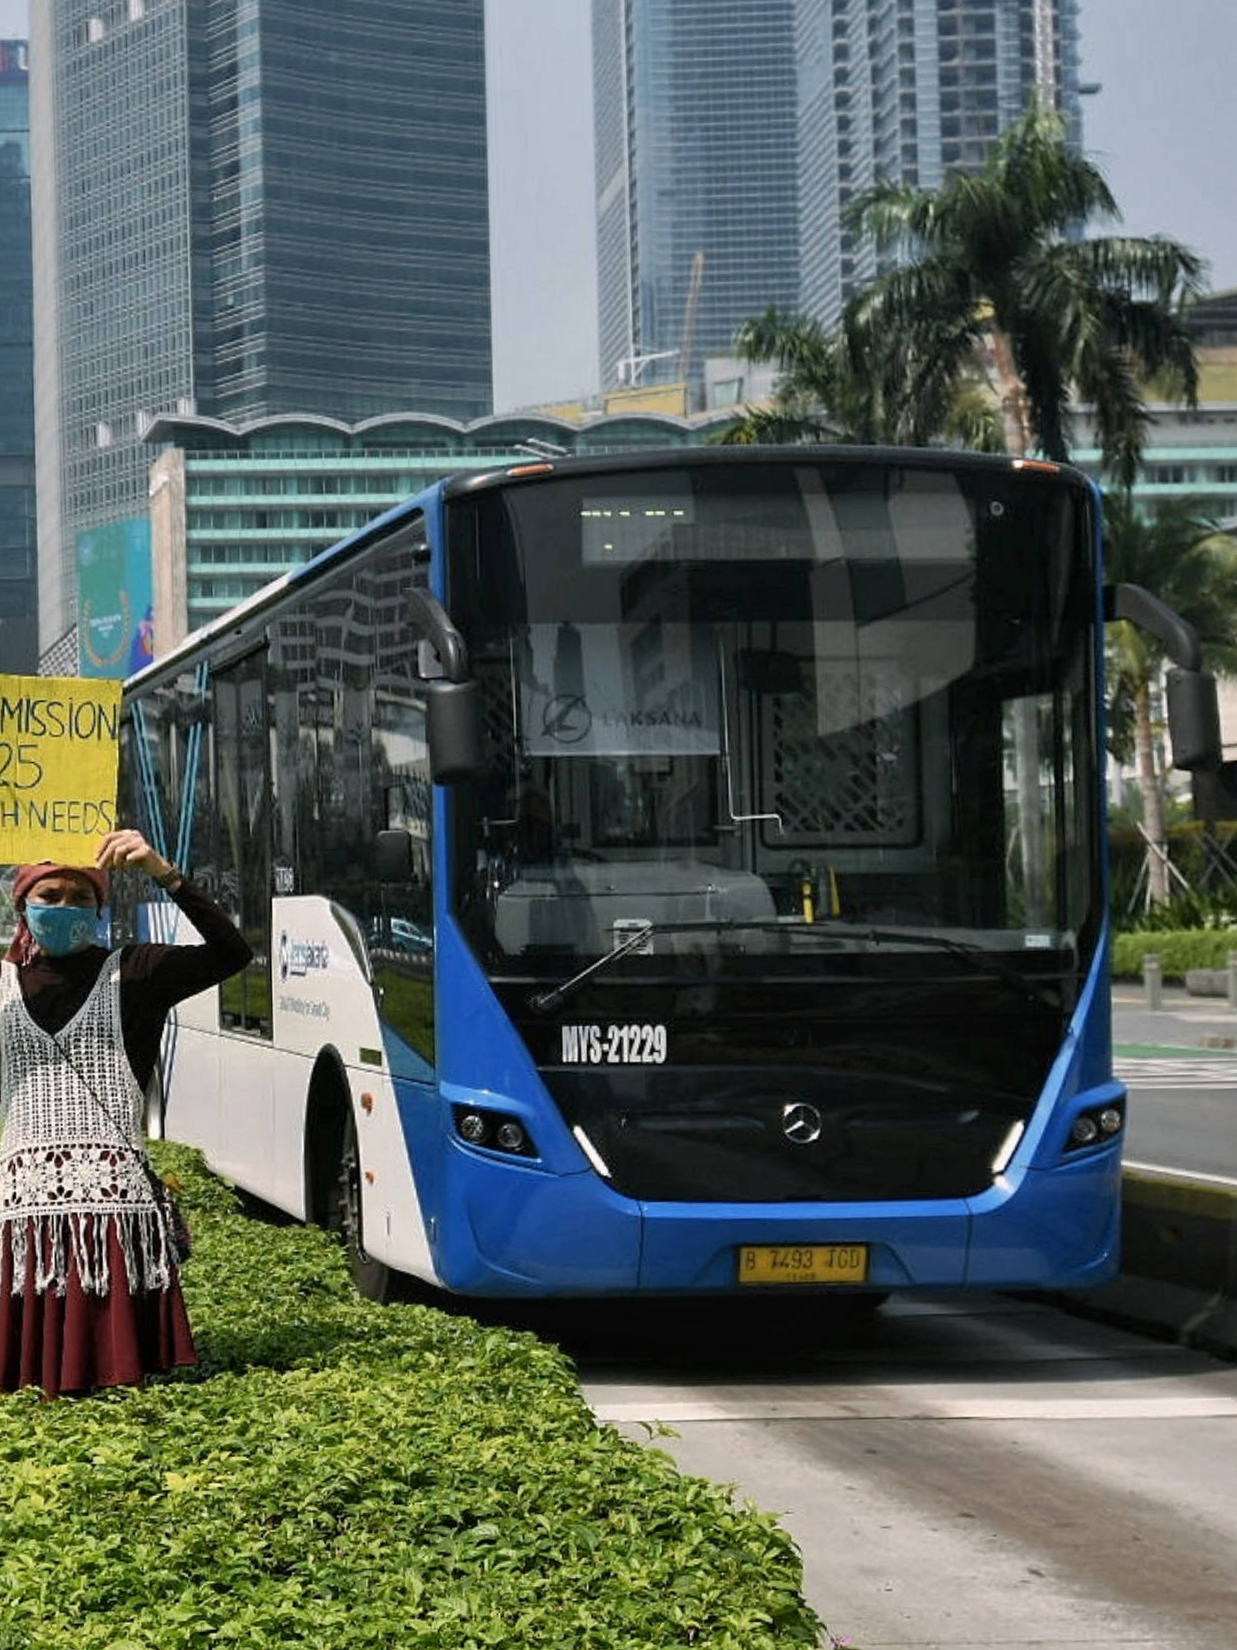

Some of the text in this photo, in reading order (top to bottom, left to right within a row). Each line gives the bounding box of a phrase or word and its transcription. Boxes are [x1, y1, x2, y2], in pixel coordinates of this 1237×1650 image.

[28, 800, 114, 836] NEEDS
[562, 1024, 667, 1064] MYS-21229
[769, 1249, 814, 1269] 7493
